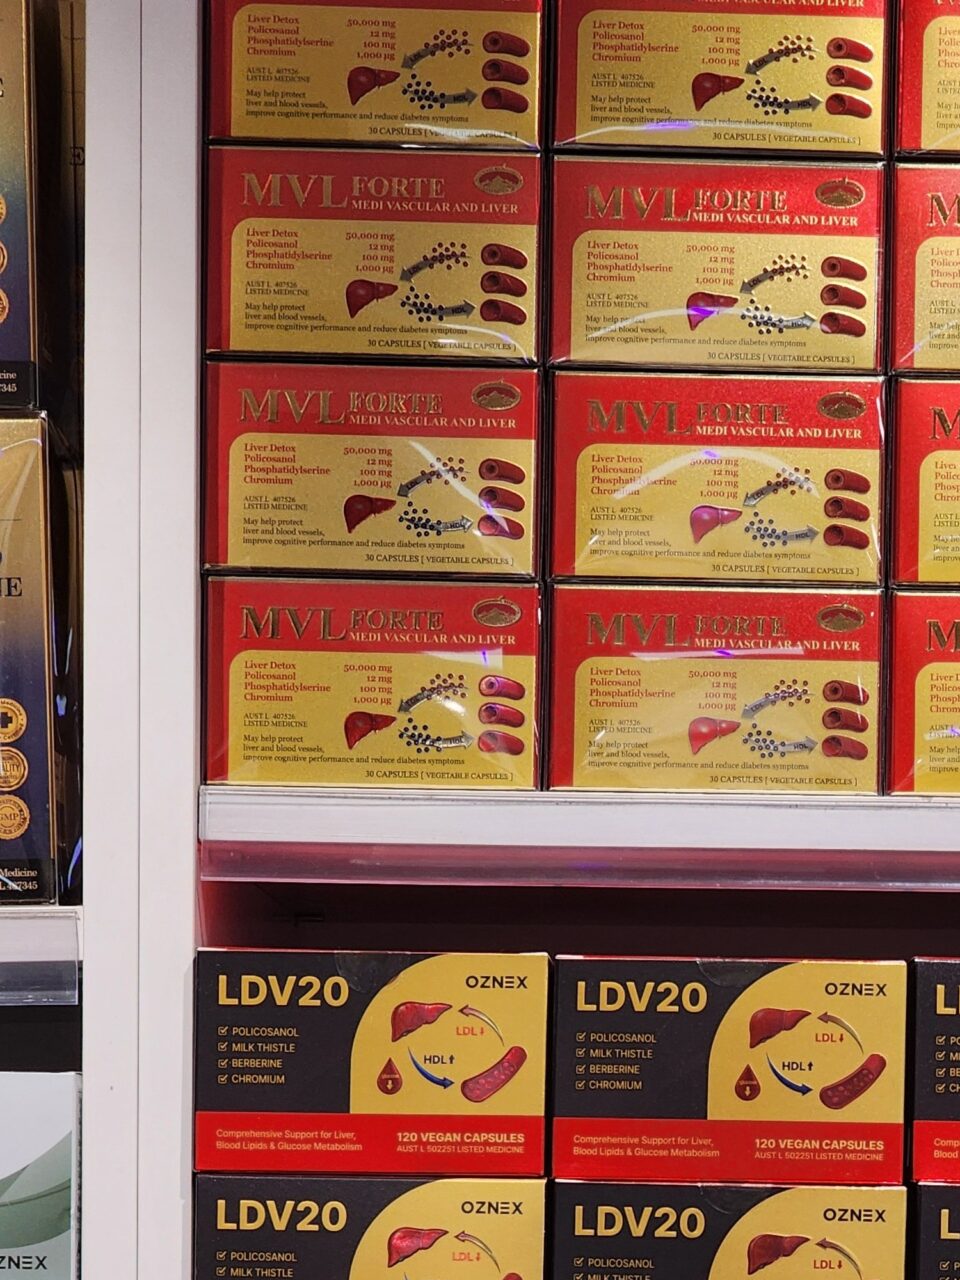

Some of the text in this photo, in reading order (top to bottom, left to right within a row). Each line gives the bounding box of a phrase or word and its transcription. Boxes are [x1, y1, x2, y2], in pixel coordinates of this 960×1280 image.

[240, 606, 348, 641] MVL
[350, 606, 446, 632] FORTE
[350, 631, 516, 646] MEDI VASCULAR AND LIVER
[245, 660, 296, 670] Liver Detox
[344, 664, 376, 672] 50,000
[243, 671, 297, 681] Policosanol
[378, 676, 392, 684] mg
[243, 682, 332, 693] Phosphatidylserine
[359, 686, 394, 696] 100 mg
[243, 692, 294, 703] Chromium
[243, 734, 304, 744] May help protect
[243, 743, 326, 754] liver and blood vessels,
[466, 976, 527, 989] OZNEX
[219, 975, 349, 1007] LDV20
[232, 1027, 299, 1037] POLICOSANOL
[456, 1026, 478, 1036] LDL
[232, 1043, 295, 1053] MILK THISTLE
[231, 1058, 284, 1070] BERBERINE
[424, 1055, 447, 1064] HDL
[232, 1074, 285, 1084] CHROMIUM
[216, 1129, 357, 1142] Comprehensive Support for Liver,
[398, 1132, 525, 1143] 120 VEGAN CAPSULES
[216, 1141, 363, 1152] Blood Lipids & Glucose Metabolism
